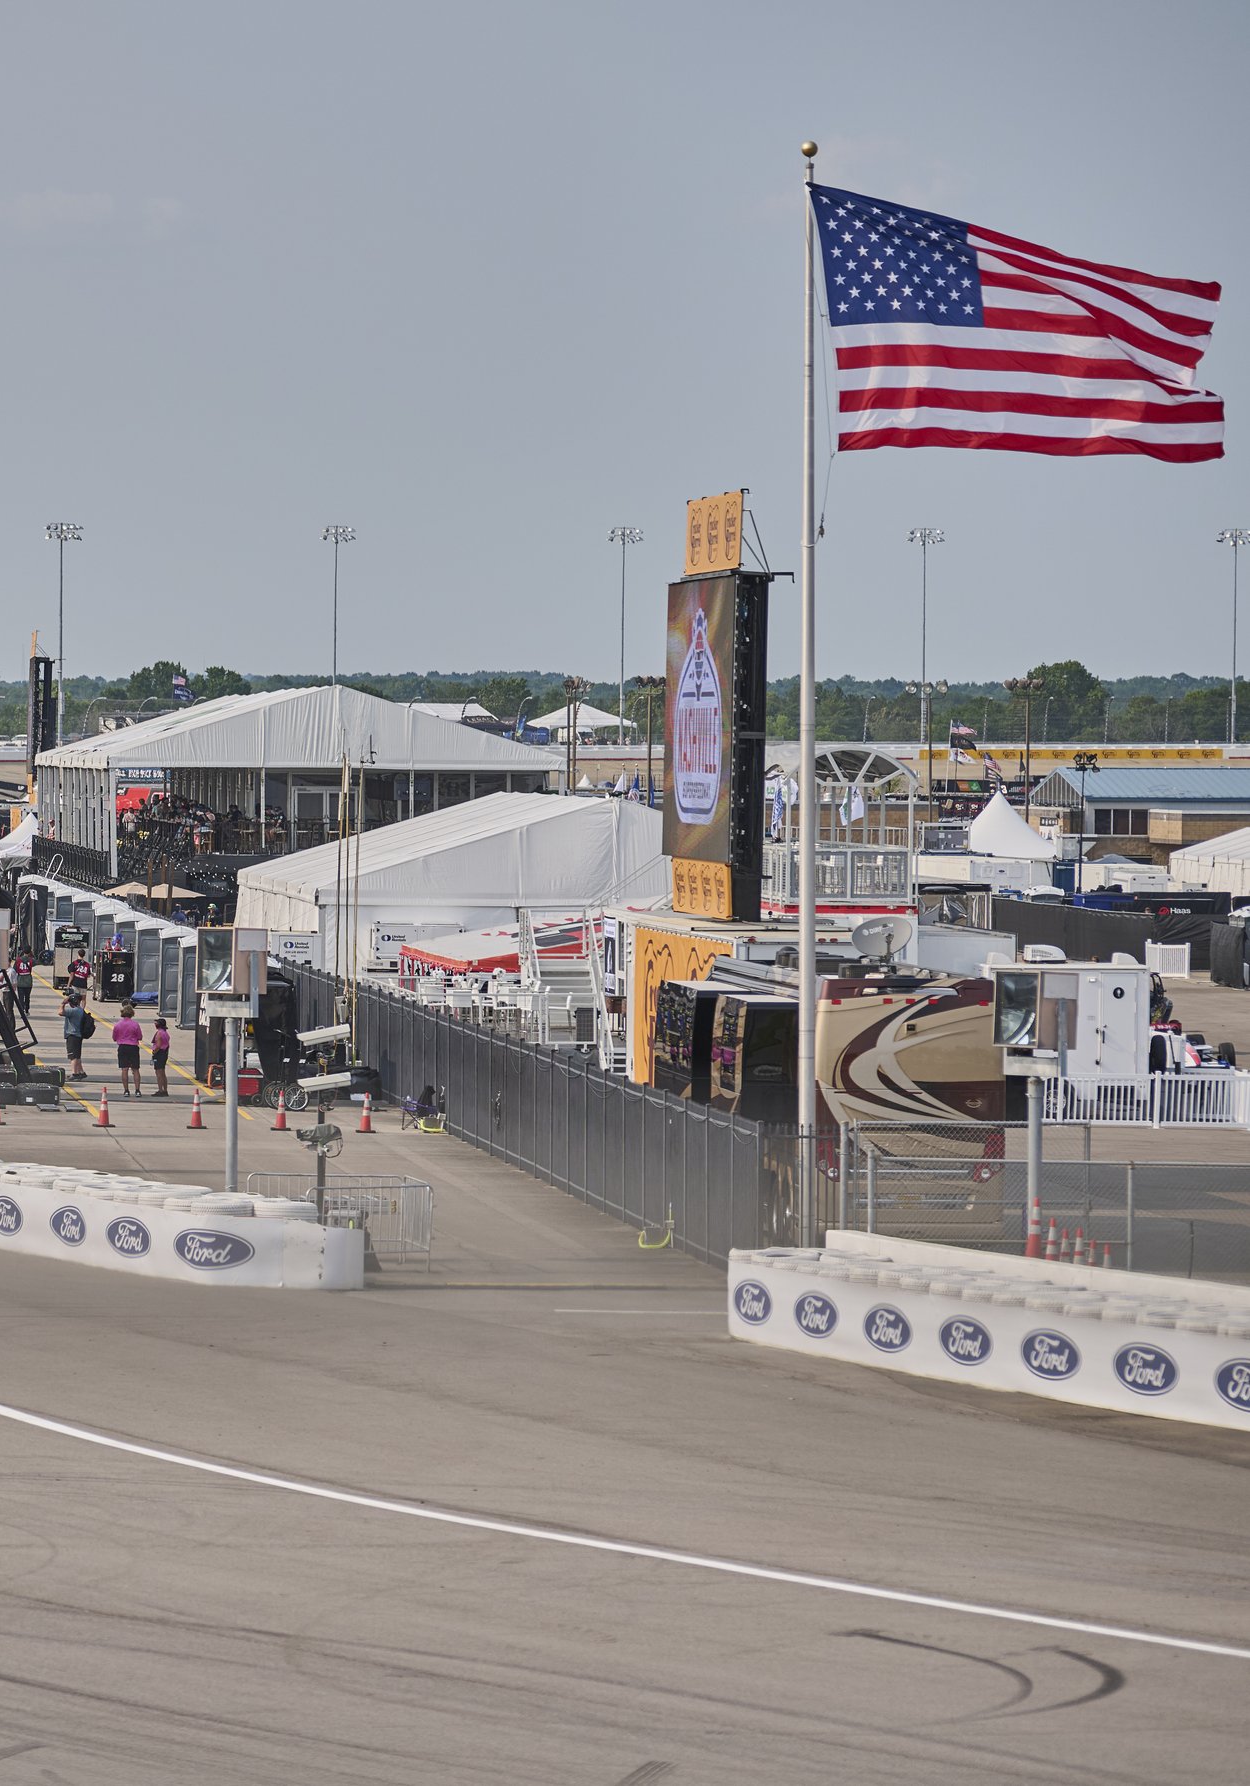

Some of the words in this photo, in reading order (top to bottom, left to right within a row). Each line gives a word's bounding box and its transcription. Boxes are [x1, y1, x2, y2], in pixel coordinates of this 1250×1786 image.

[678, 707, 717, 774] NASHVILLE
[110, 973, 125, 983] 28
[60, 1211, 82, 1240] Ford
[114, 1222, 143, 1252] Ford
[184, 1234, 232, 1263] Ford
[740, 1284, 765, 1318] Ford
[801, 1296, 830, 1331] Ford
[871, 1309, 903, 1345] Ford
[949, 1322, 982, 1358] Ford
[1029, 1336, 1070, 1374] Ford
[1124, 1350, 1166, 1388] Ford
[1227, 1365, 1250, 1401] Fo
